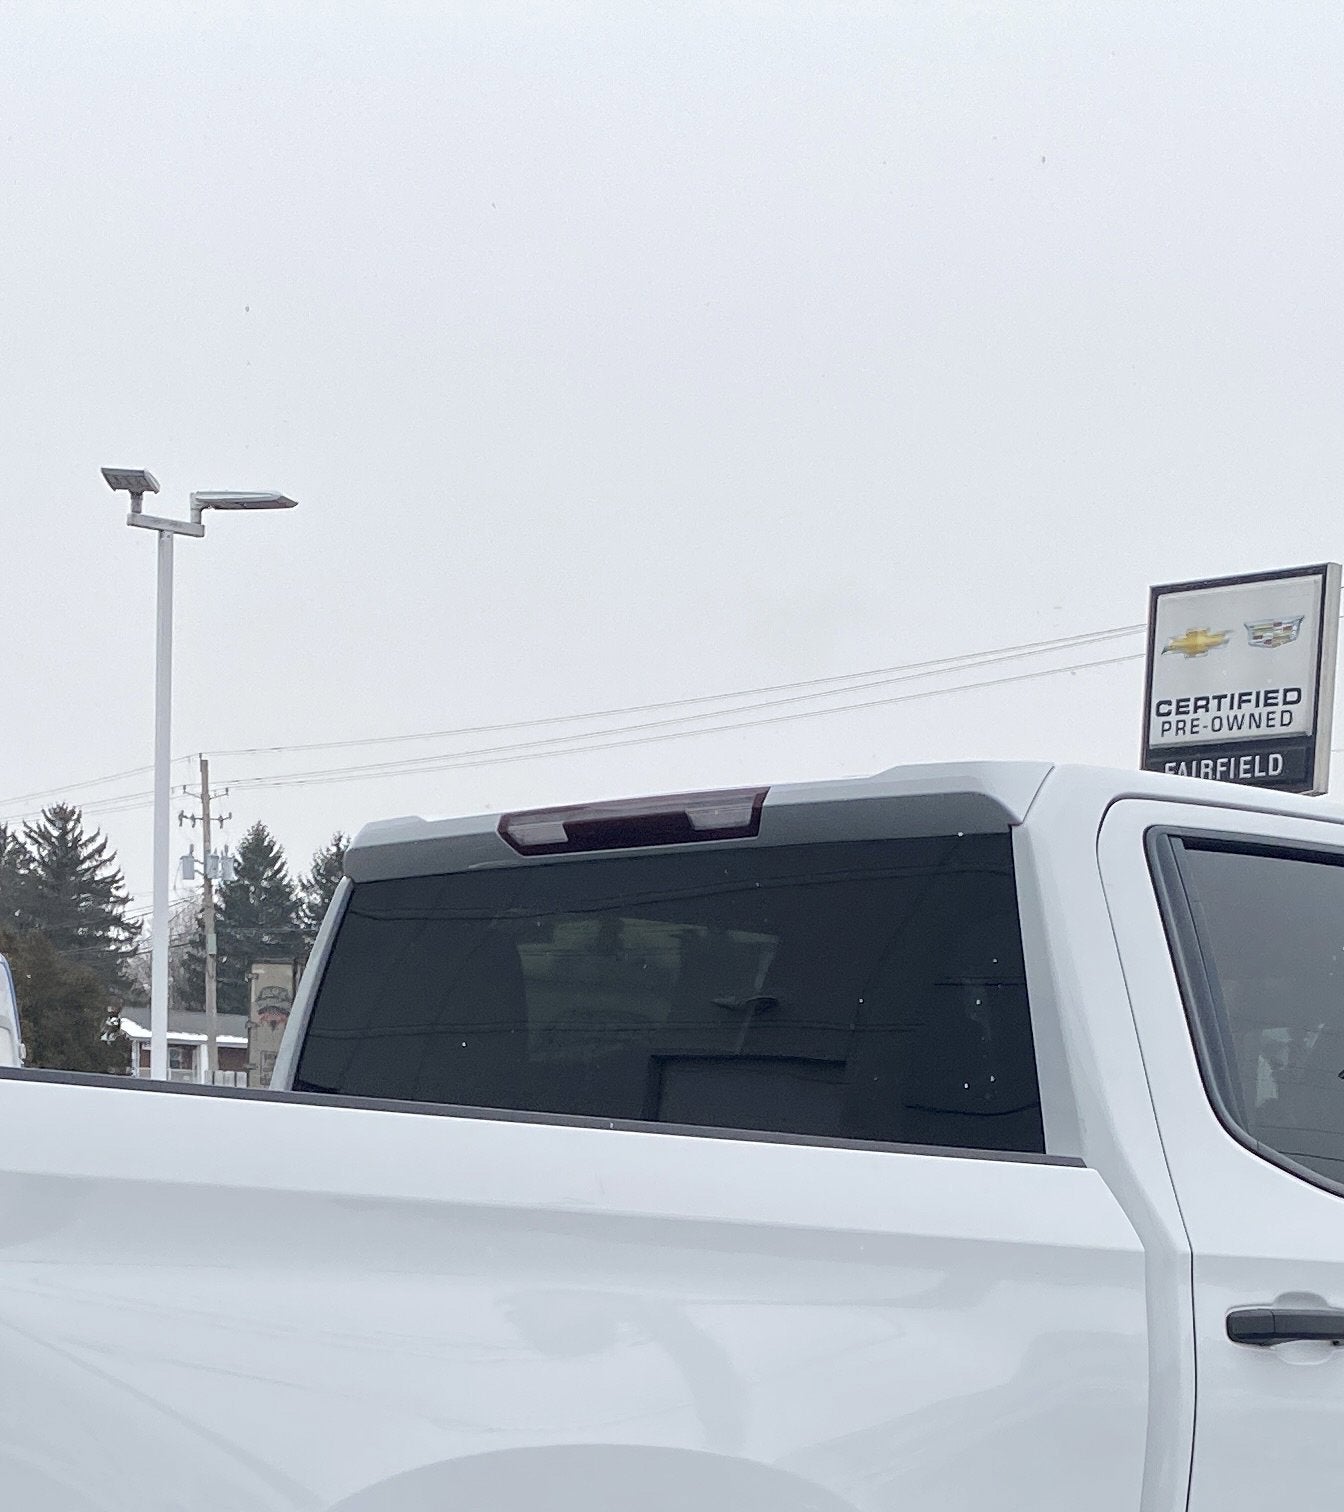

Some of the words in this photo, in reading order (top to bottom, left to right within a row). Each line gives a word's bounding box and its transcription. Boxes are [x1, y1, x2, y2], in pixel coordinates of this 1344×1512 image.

[1156, 687, 1302, 717] CERTIFIED
[1161, 709, 1294, 737] PRE-OWNED
[1163, 753, 1284, 780] FAIRFIELD
